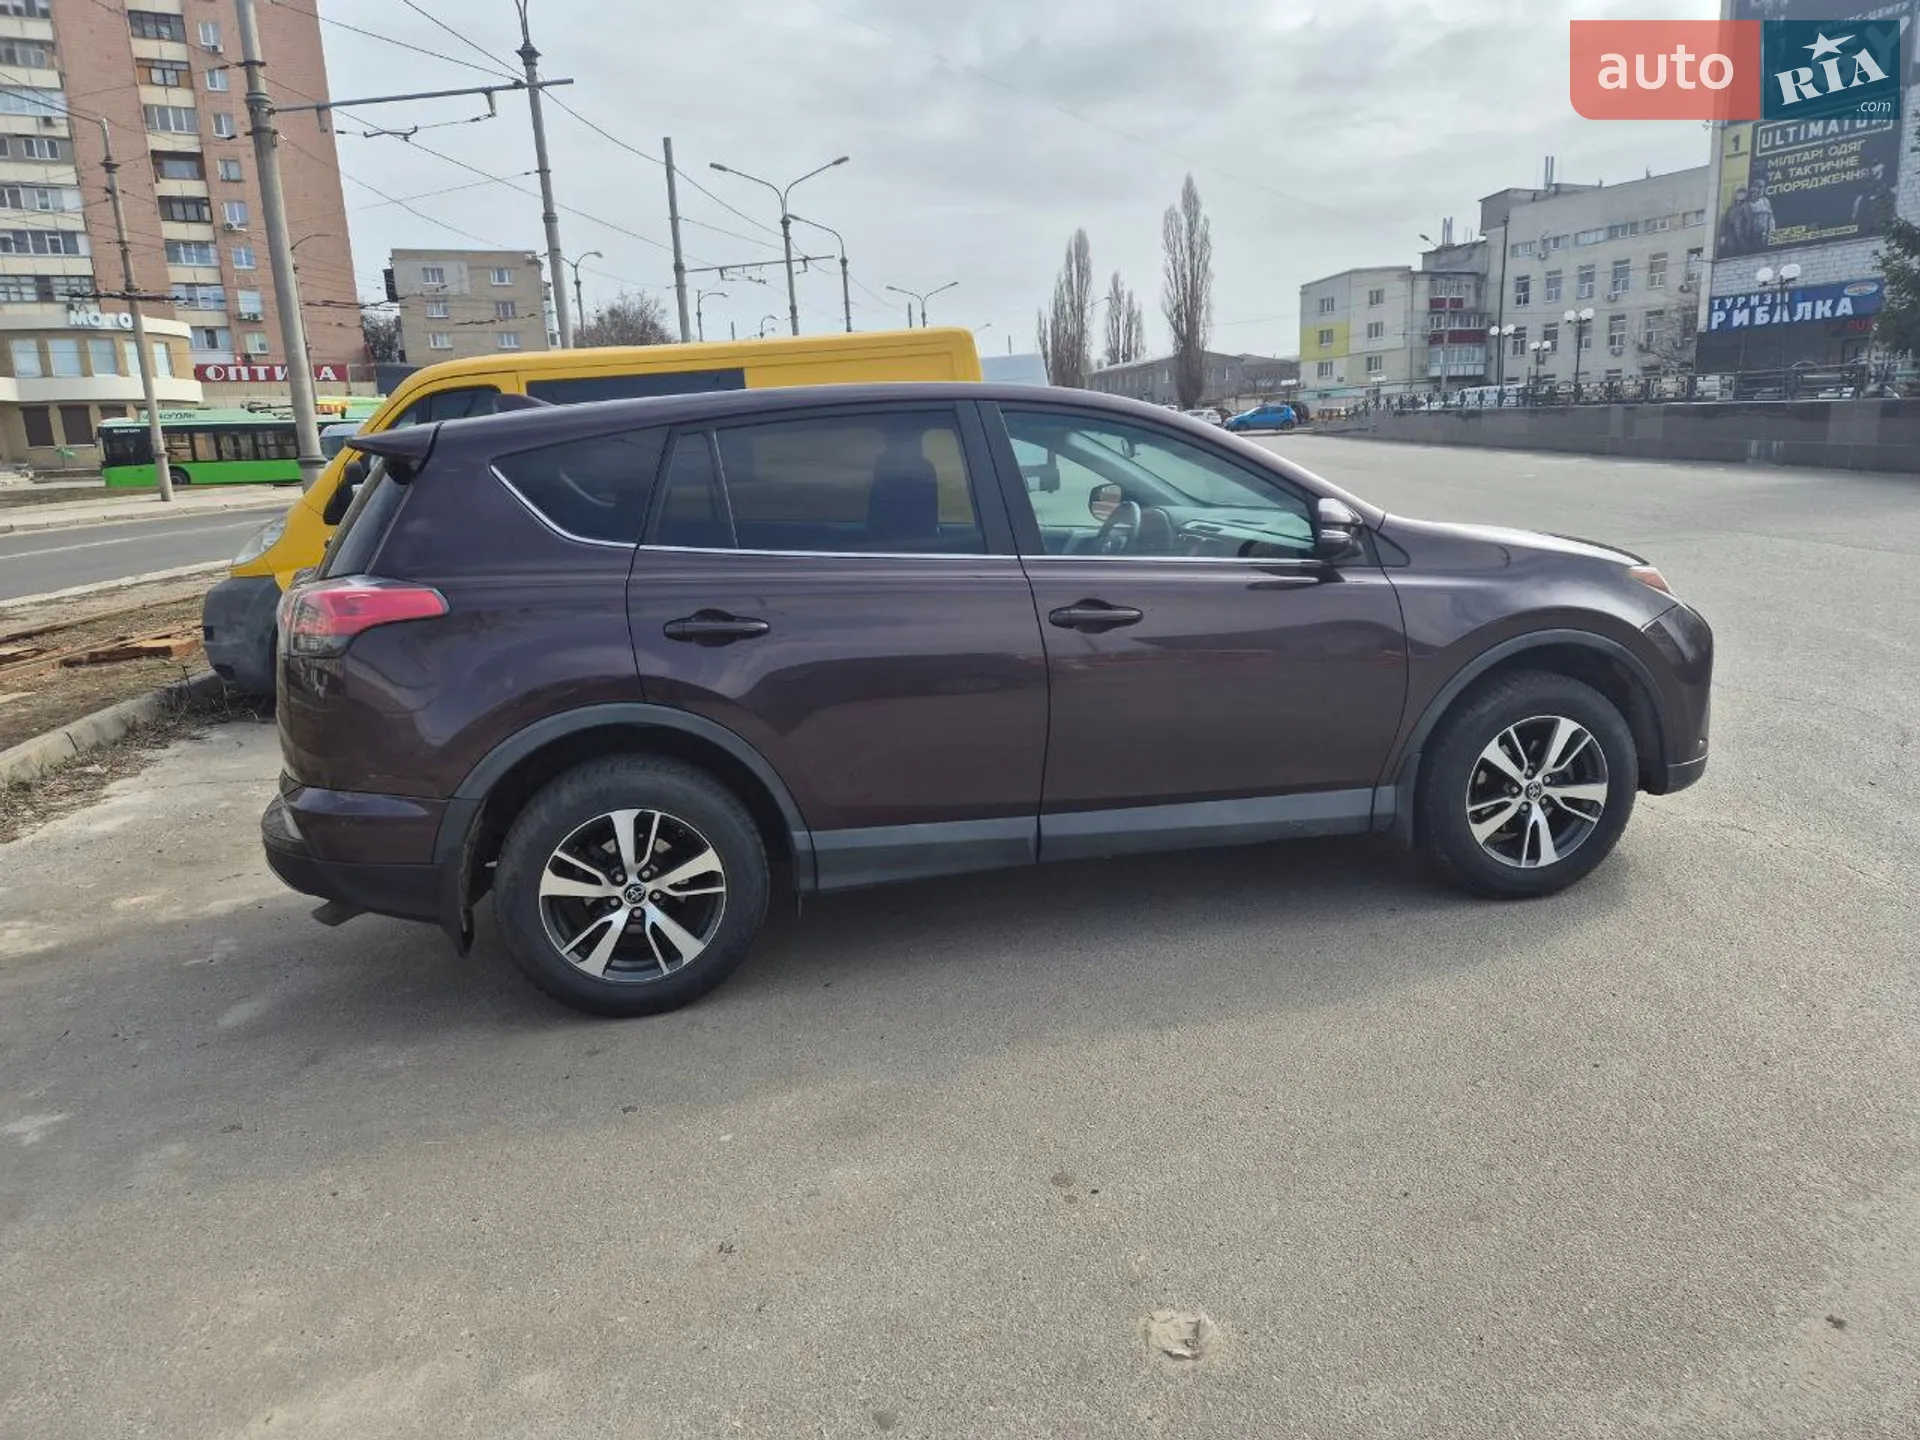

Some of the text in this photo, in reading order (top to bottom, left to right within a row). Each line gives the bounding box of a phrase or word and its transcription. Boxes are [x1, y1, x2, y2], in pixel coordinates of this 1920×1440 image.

[1767, 156, 1859, 182] ТА ТАКТИЧНЕ
[1711, 297, 1853, 330] РИБАЛКА
[205, 365, 337, 381] ОПТИА
